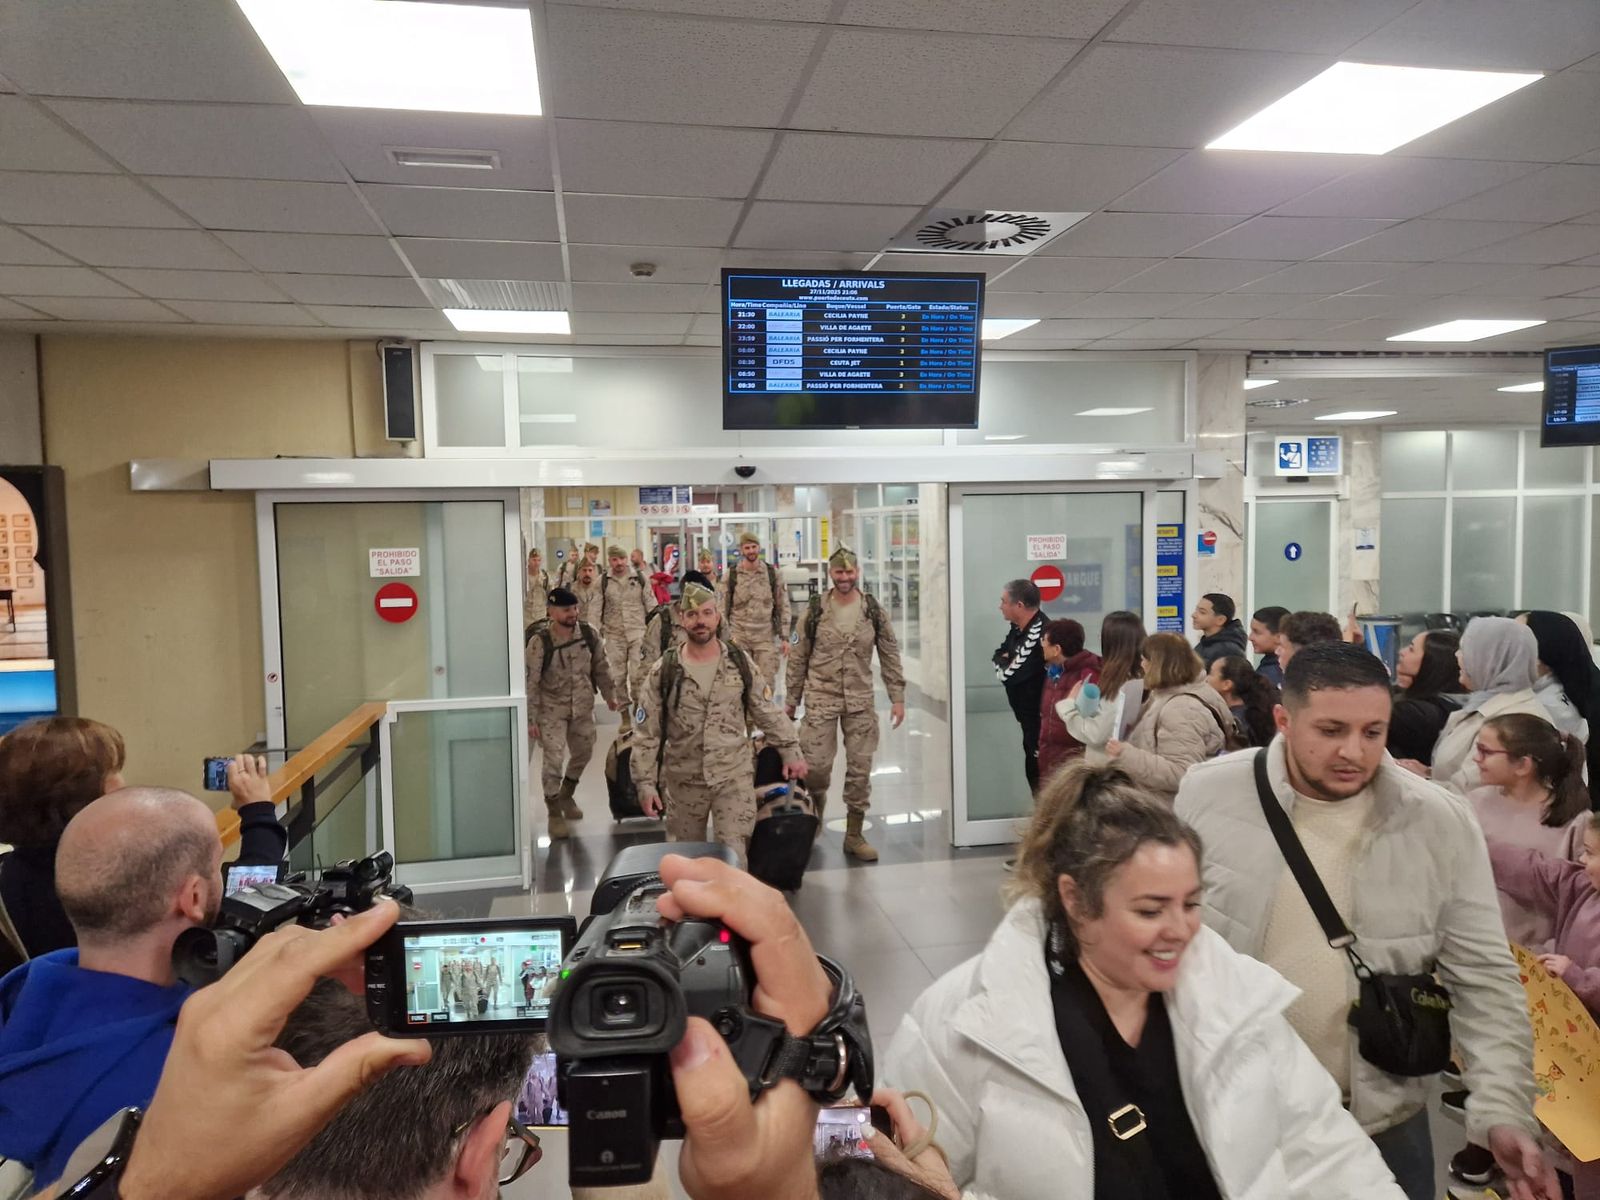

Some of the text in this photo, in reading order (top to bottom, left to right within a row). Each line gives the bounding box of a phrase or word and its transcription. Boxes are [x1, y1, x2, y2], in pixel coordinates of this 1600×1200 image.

[782, 279, 885, 288] LLEGADAS / ARRIVALS
[586, 1110, 627, 1120] Canon
